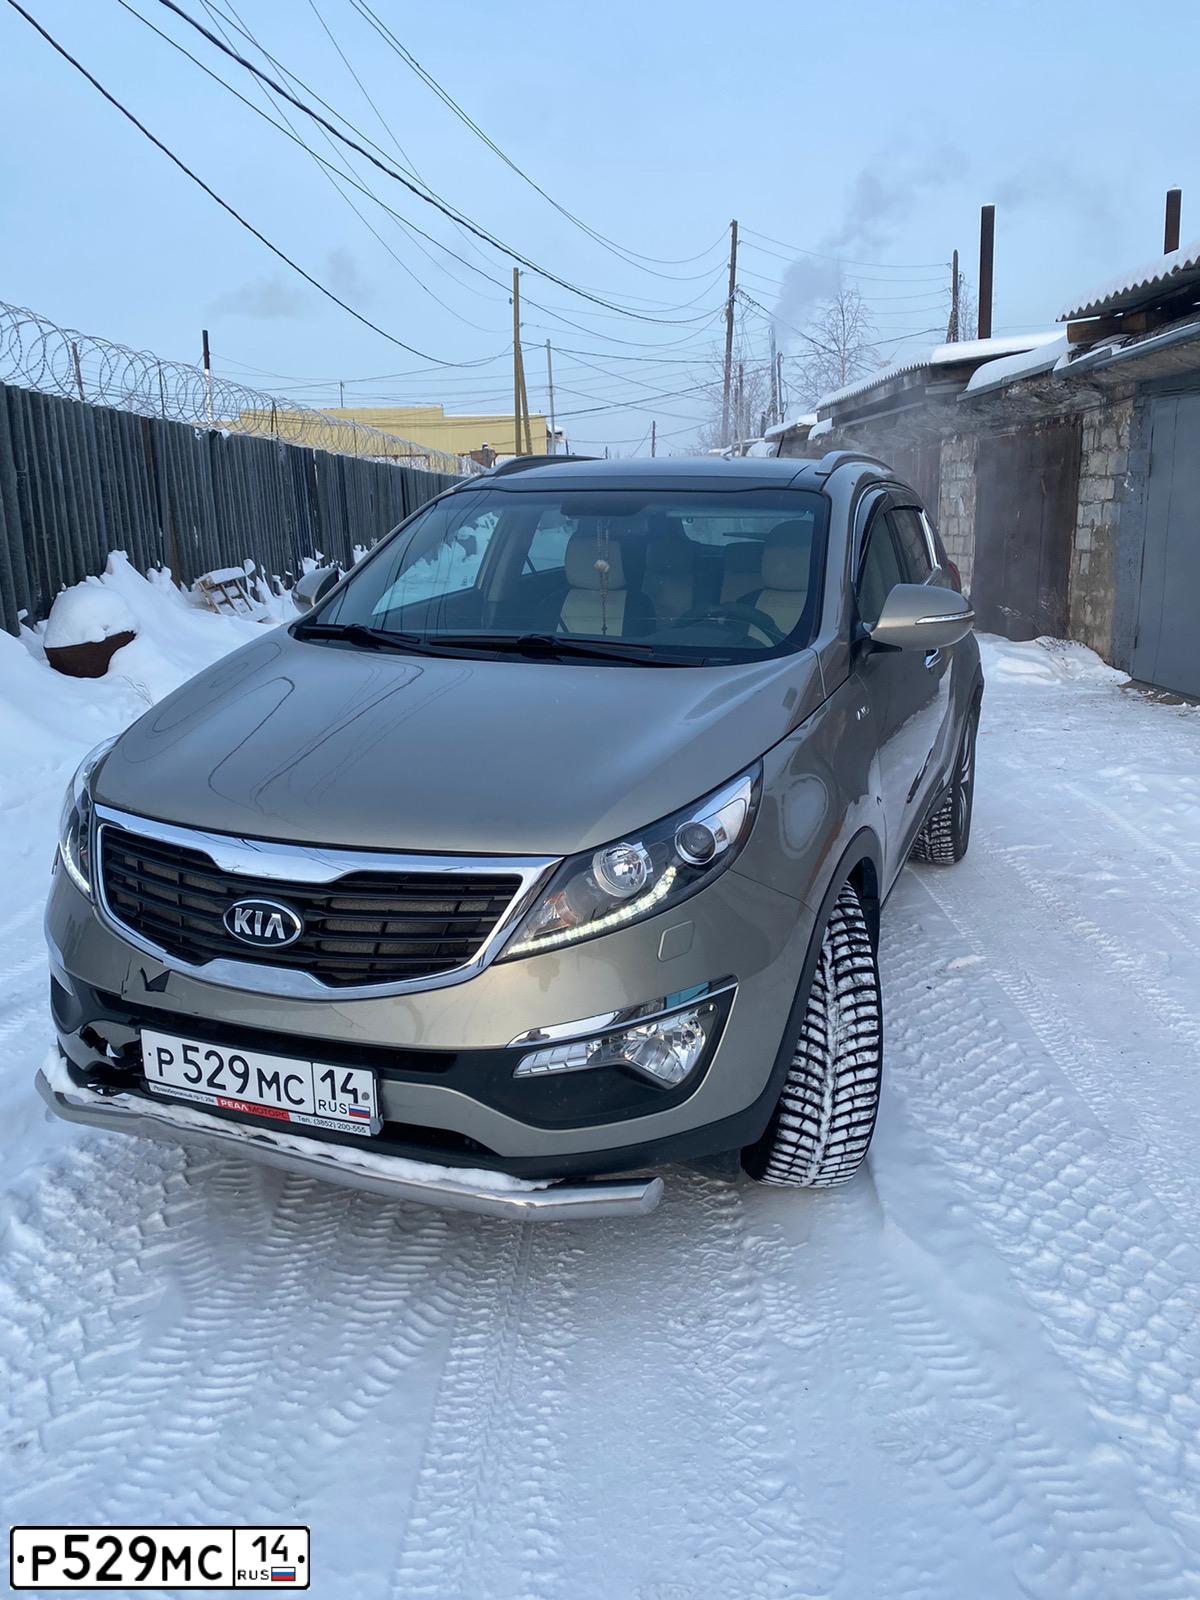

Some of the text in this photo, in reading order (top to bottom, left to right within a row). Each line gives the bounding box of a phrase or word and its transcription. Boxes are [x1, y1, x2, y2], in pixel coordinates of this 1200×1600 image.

[234, 907, 286, 940] KIA
[320, 1069, 358, 1104] 14
[318, 1099, 347, 1115] RUS
